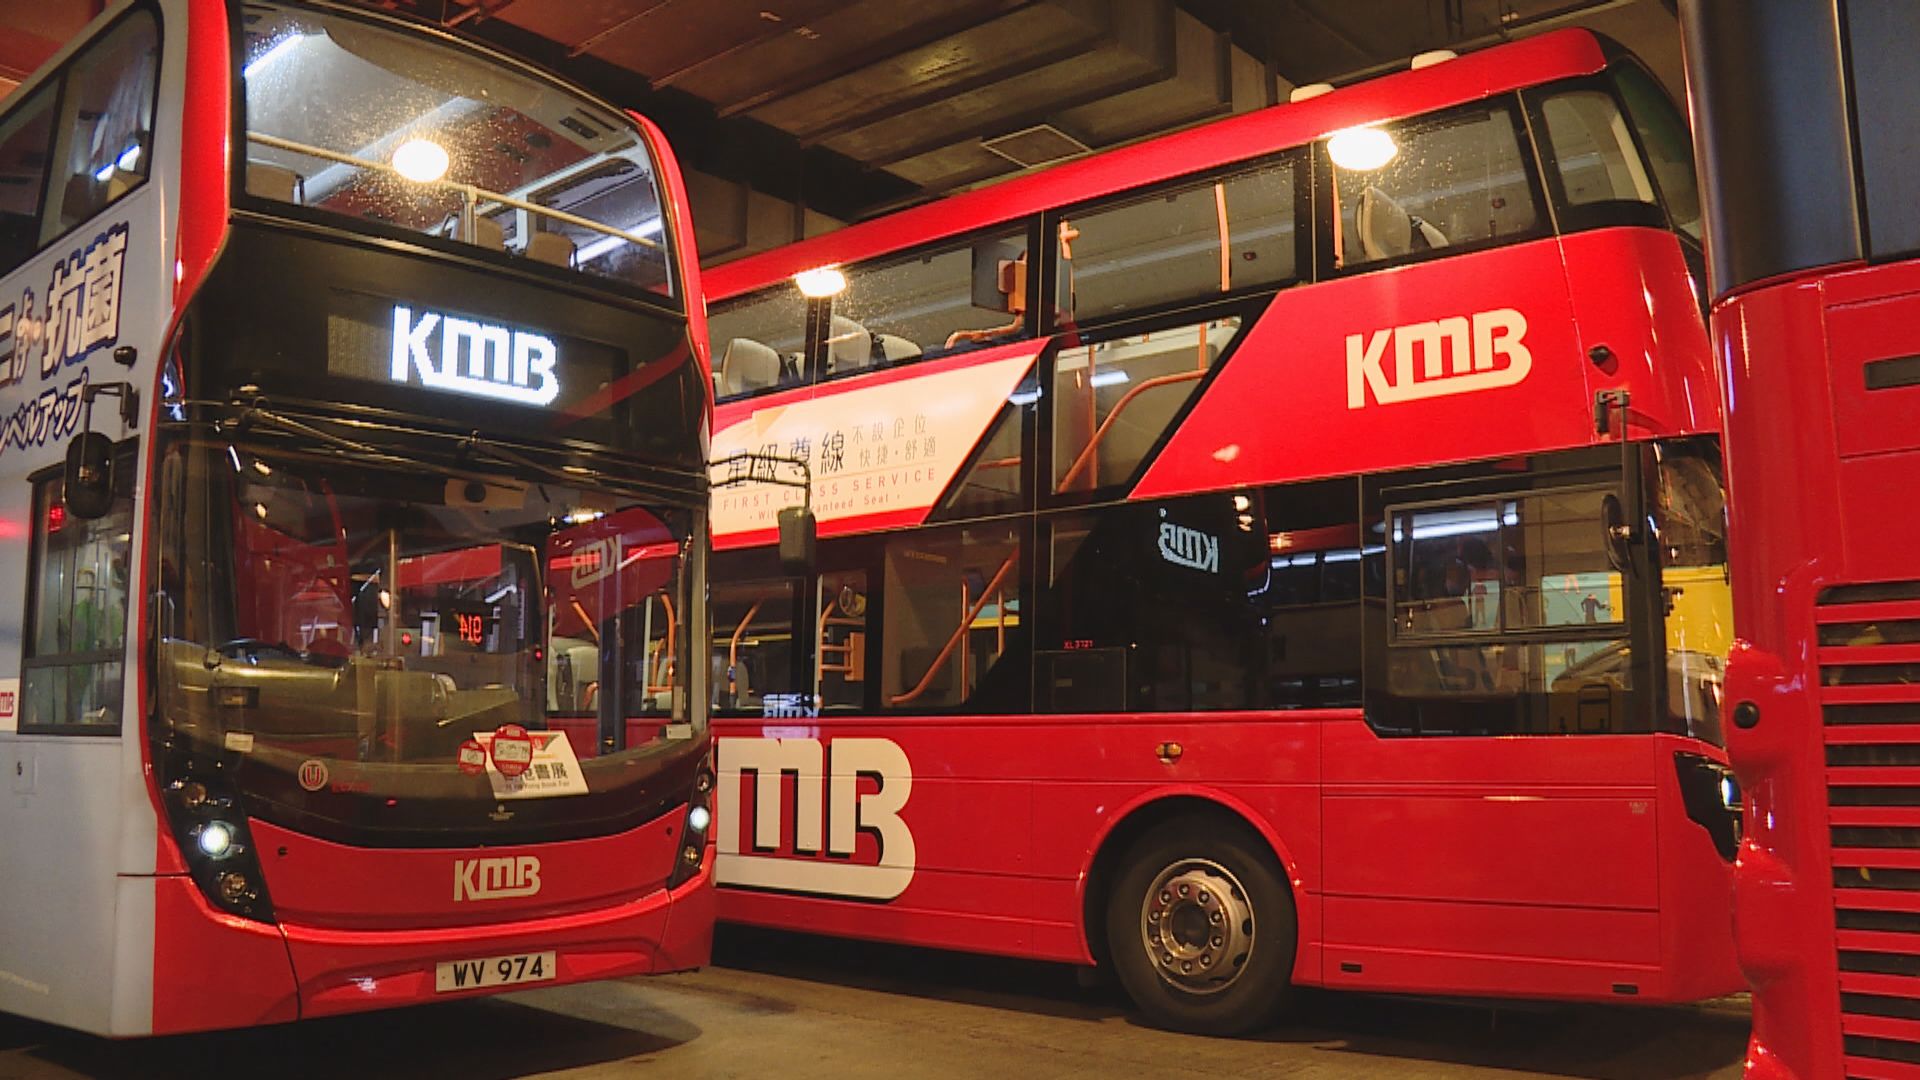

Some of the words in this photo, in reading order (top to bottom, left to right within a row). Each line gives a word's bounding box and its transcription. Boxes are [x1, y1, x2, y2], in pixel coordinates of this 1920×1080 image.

[391, 304, 560, 407] KMB
[1345, 307, 1532, 409] KMB
[723, 492, 771, 512] FIRST
[852, 467, 937, 492] SERVICE
[758, 508, 779, 521] Wit
[811, 498, 854, 514] ranteed
[0, 691, 14, 717] MB
[713, 737, 916, 905] MB
[454, 855, 541, 902] KMB
[453, 960, 485, 987] WV
[497, 955, 544, 981] 974
